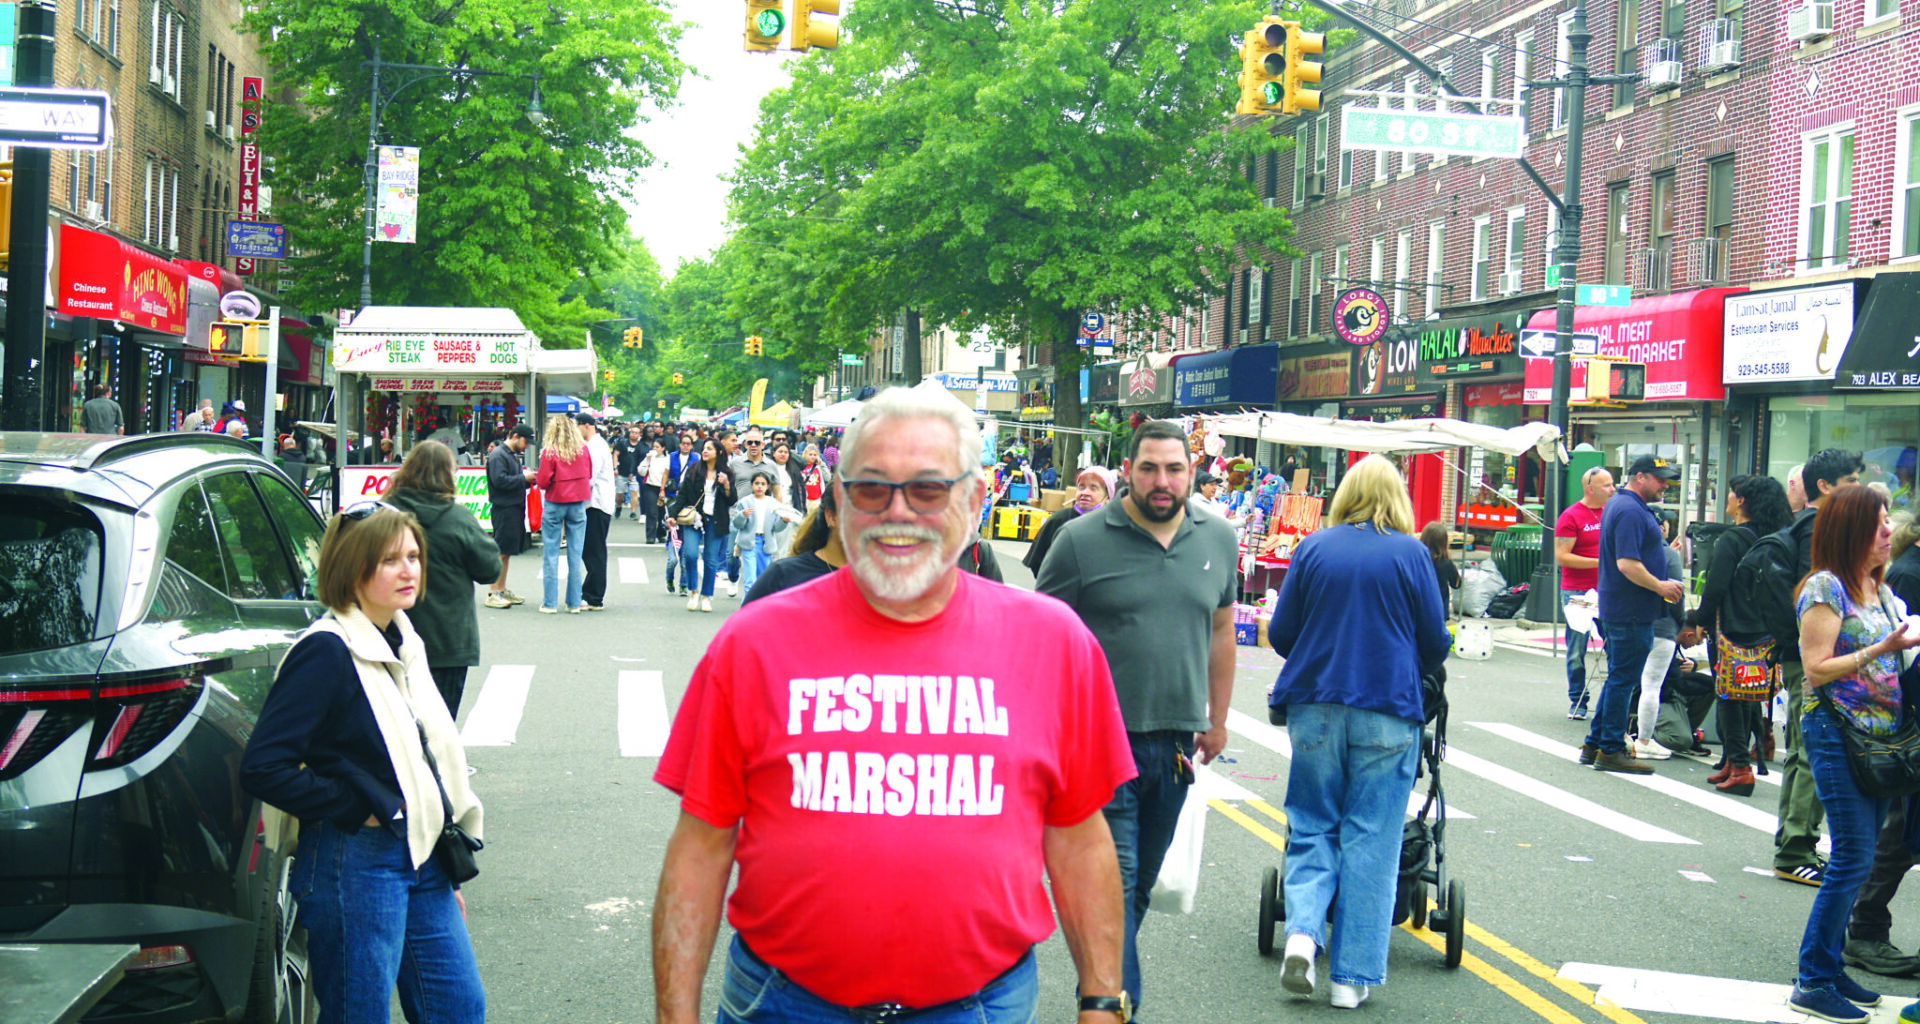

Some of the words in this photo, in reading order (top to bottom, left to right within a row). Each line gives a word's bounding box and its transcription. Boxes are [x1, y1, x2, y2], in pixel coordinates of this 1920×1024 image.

[42, 108, 88, 128] WAY
[1386, 118, 1428, 145] 80
[73, 282, 107, 295] Chinese
[133, 268, 155, 304] HING
[156, 268, 177, 315] WONG
[67, 298, 114, 311] Restaurant
[1768, 295, 1796, 316] Jamal
[1618, 320, 1653, 343] MEAT
[1731, 322, 1767, 336] Esthetician
[1769, 320, 1799, 333] Services
[386, 340, 402, 352] RIB
[405, 340, 426, 352] EYE
[433, 340, 473, 352] SAUSAGE
[475, 341, 482, 351] &
[495, 341, 516, 353] HOT
[973, 340, 993, 353] 25
[1420, 328, 1458, 361] HALAL
[1467, 321, 1514, 356] Munchies
[388, 351, 422, 363] STEAK
[437, 351, 477, 363] PEPPERS
[489, 352, 519, 364] DOGS
[1388, 338, 1418, 374] LON
[1628, 339, 1687, 363] MARKET
[1737, 361, 1791, 377] 929-545-5588
[1868, 371, 1897, 386] ALEX
[786, 673, 1010, 737] FESTIVAL
[787, 751, 1004, 817] MARSHAL
